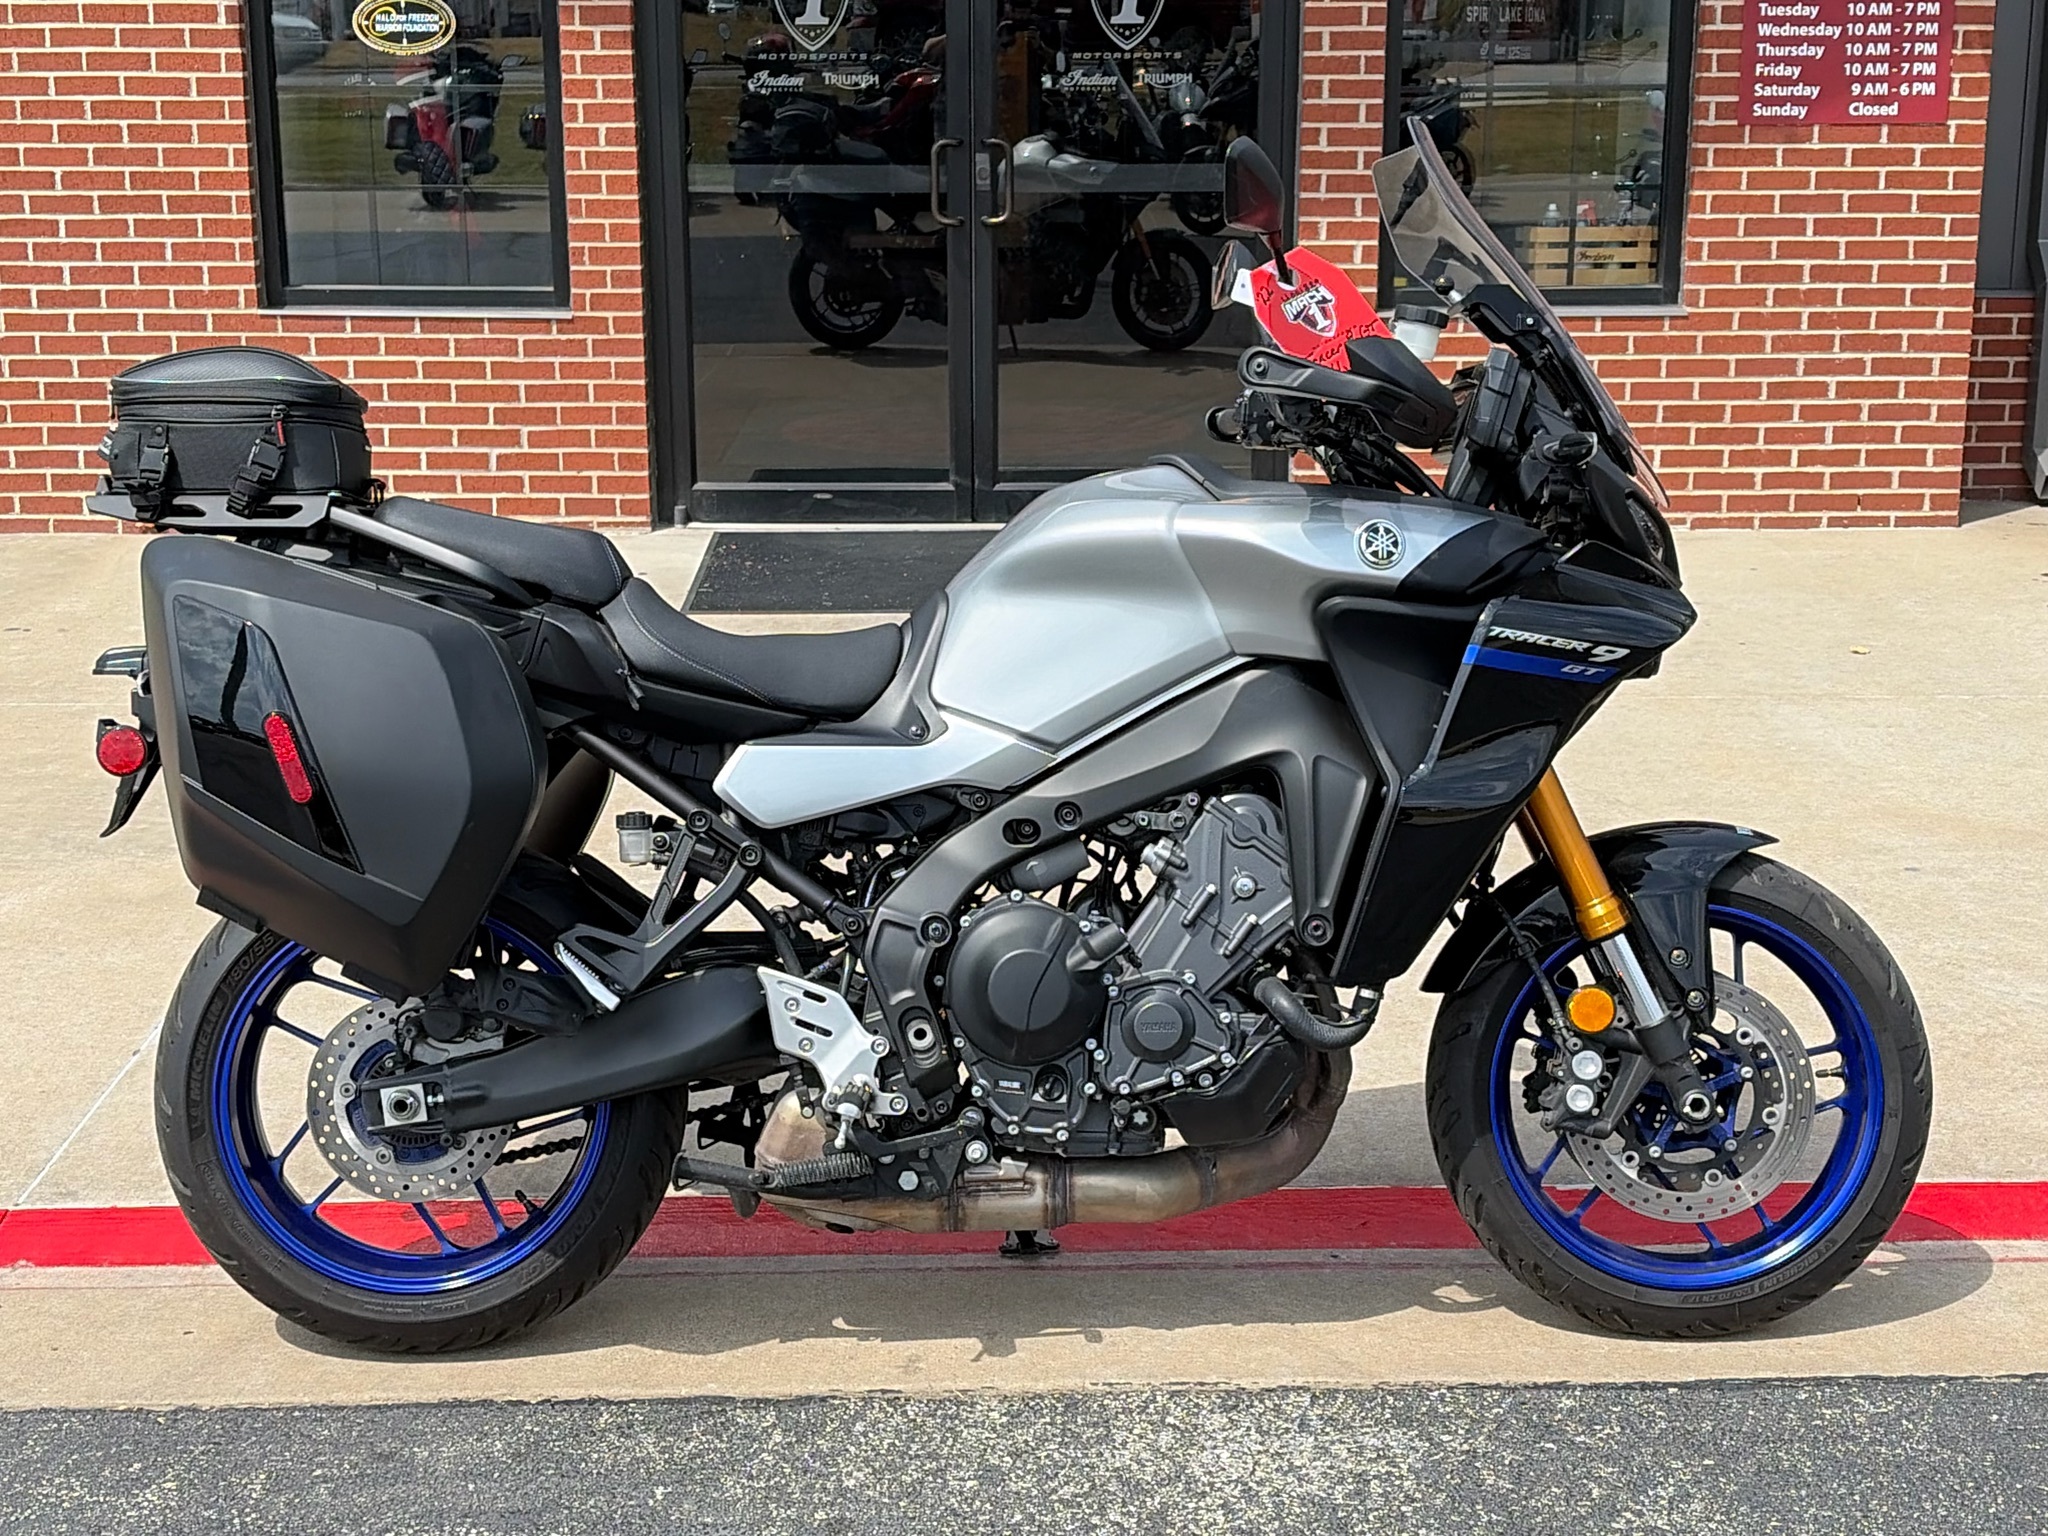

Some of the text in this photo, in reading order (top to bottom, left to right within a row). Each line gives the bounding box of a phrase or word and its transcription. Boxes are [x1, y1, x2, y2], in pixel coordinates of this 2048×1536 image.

[375, 13, 395, 21] HALO
[408, 13, 440, 21] FREEDOM
[1466, 6, 1490, 22] SPIR
[1500, 6, 1522, 22] LAKE
[1759, 3, 1819, 19] Tuesday
[1847, 3, 1866, 16] 10
[1868, 3, 1893, 16] AM
[1904, 3, 1914, 16] 7
[1916, 3, 1940, 16] PM
[403, 24, 440, 32] FOUNDATION
[1757, 23, 1842, 39] Wednesday
[1846, 23, 1864, 36] 10
[1866, 23, 1891, 36] AM
[1903, 23, 1912, 36] 7
[1915, 23, 1938, 36] PM
[1756, 43, 1825, 59] Thursday
[1845, 43, 1863, 56] 10
[1865, 43, 1890, 56] AM
[1902, 43, 1911, 56] 7
[1914, 43, 1937, 56] PM
[748, 70, 804, 88] Indian
[1061, 69, 1118, 87] Indian
[1755, 63, 1801, 79] Friday
[1844, 63, 1861, 76] 10
[1864, 63, 1889, 76] AM
[1900, 63, 1910, 76] 7
[1913, 63, 1936, 76] PM
[822, 72, 879, 87] TRIUMPH
[1136, 73, 1193, 87] TRIUMPH
[1754, 83, 1820, 99] Saturday
[1851, 83, 1861, 96] 9
[1863, 83, 1888, 96] AM
[1899, 83, 1909, 96] 6
[1912, 83, 1935, 96] PM
[1753, 102, 1898, 119] Sunday Closed
[1284, 286, 1333, 319] MACH
[1308, 303, 1331, 330] 1
[1487, 626, 1631, 662] TRACER 9
[1560, 664, 1606, 676] GT
[226, 932, 276, 990] 180/55
[1762, 1252, 1819, 1290] MICHELIN
